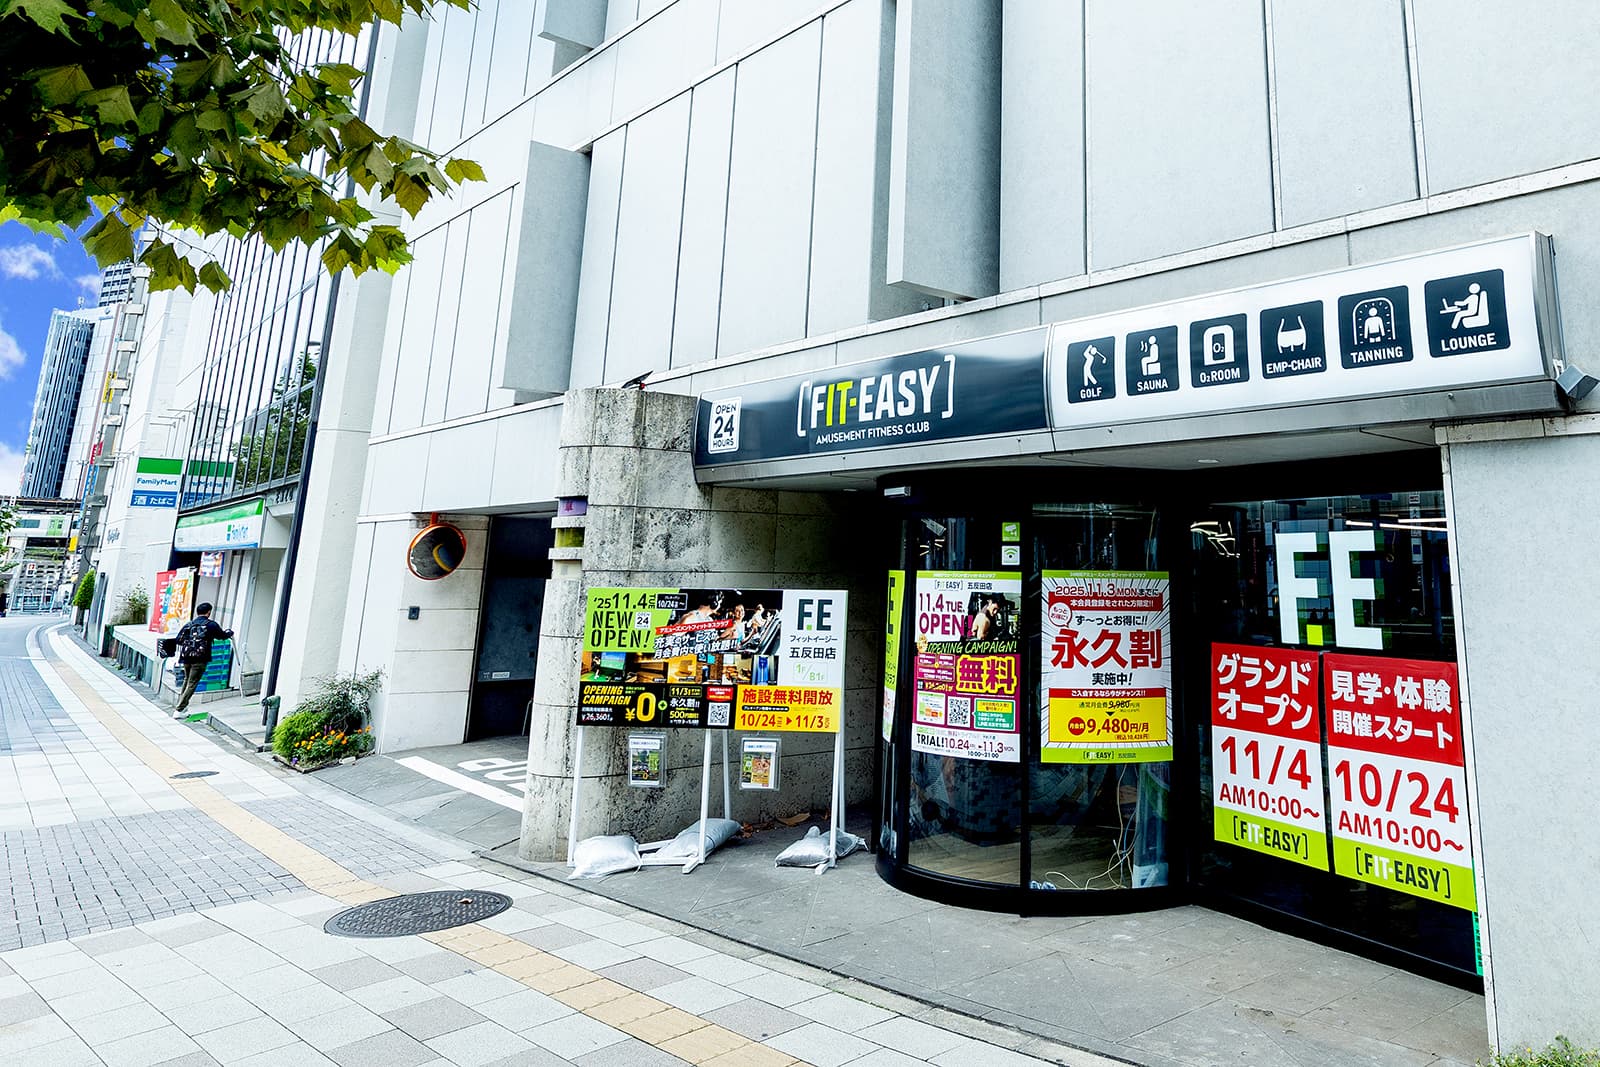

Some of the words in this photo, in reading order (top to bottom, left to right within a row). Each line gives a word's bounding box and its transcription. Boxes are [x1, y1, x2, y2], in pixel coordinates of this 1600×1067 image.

[1441, 332, 1497, 352] LOUNGE
[1350, 346, 1404, 364] TANNING
[1266, 356, 1323, 374] EMP-CHAIR
[1080, 387, 1103, 399] GOLF
[1136, 378, 1169, 392] SAUNA
[715, 403, 737, 415] OPEN
[713, 414, 735, 439] 24
[816, 429, 866, 445] AMUSEMENT
[867, 424, 904, 439] FITNESS
[904, 421, 930, 434] CLUB
[712, 437, 735, 448] HOURS
[136, 476, 178, 487] FamilyMart
[133, 495, 147, 505] 酒
[149, 494, 175, 506] たばこ
[1055, 583, 1116, 597] 2025.11.3
[612, 592, 648, 609] 11.4
[919, 592, 945, 613] 11.4
[945, 601, 965, 613] TUE.
[592, 610, 634, 629] NEW
[636, 616, 649, 625] 24
[919, 612, 974, 637] OPEN!
[590, 629, 652, 648] OPEN!
[789, 647, 836, 659] 五反田店
[927, 643, 964, 655] OPENING
[965, 641, 1018, 654] CAMPAIGN!
[1050, 628, 1162, 669] 永久割
[957, 655, 1016, 694] 無料
[1092, 672, 1133, 685] 実施中!
[1217, 653, 1312, 694] グランド
[583, 685, 623, 695] OPENING
[742, 689, 833, 705] 施設無料開放
[1331, 669, 1452, 714] 見学・体験
[582, 695, 631, 705] CAMPAIGN
[1217, 688, 1313, 730] オープン
[741, 713, 776, 727] 10/24
[796, 715, 824, 728] 11/3
[1332, 709, 1453, 749] 開催スタート
[917, 734, 944, 748] TRIAL!
[944, 737, 969, 750] 10.24
[983, 741, 1004, 753] 11.3
[1220, 735, 1312, 790] 11/4
[1335, 759, 1459, 824] 10/24
